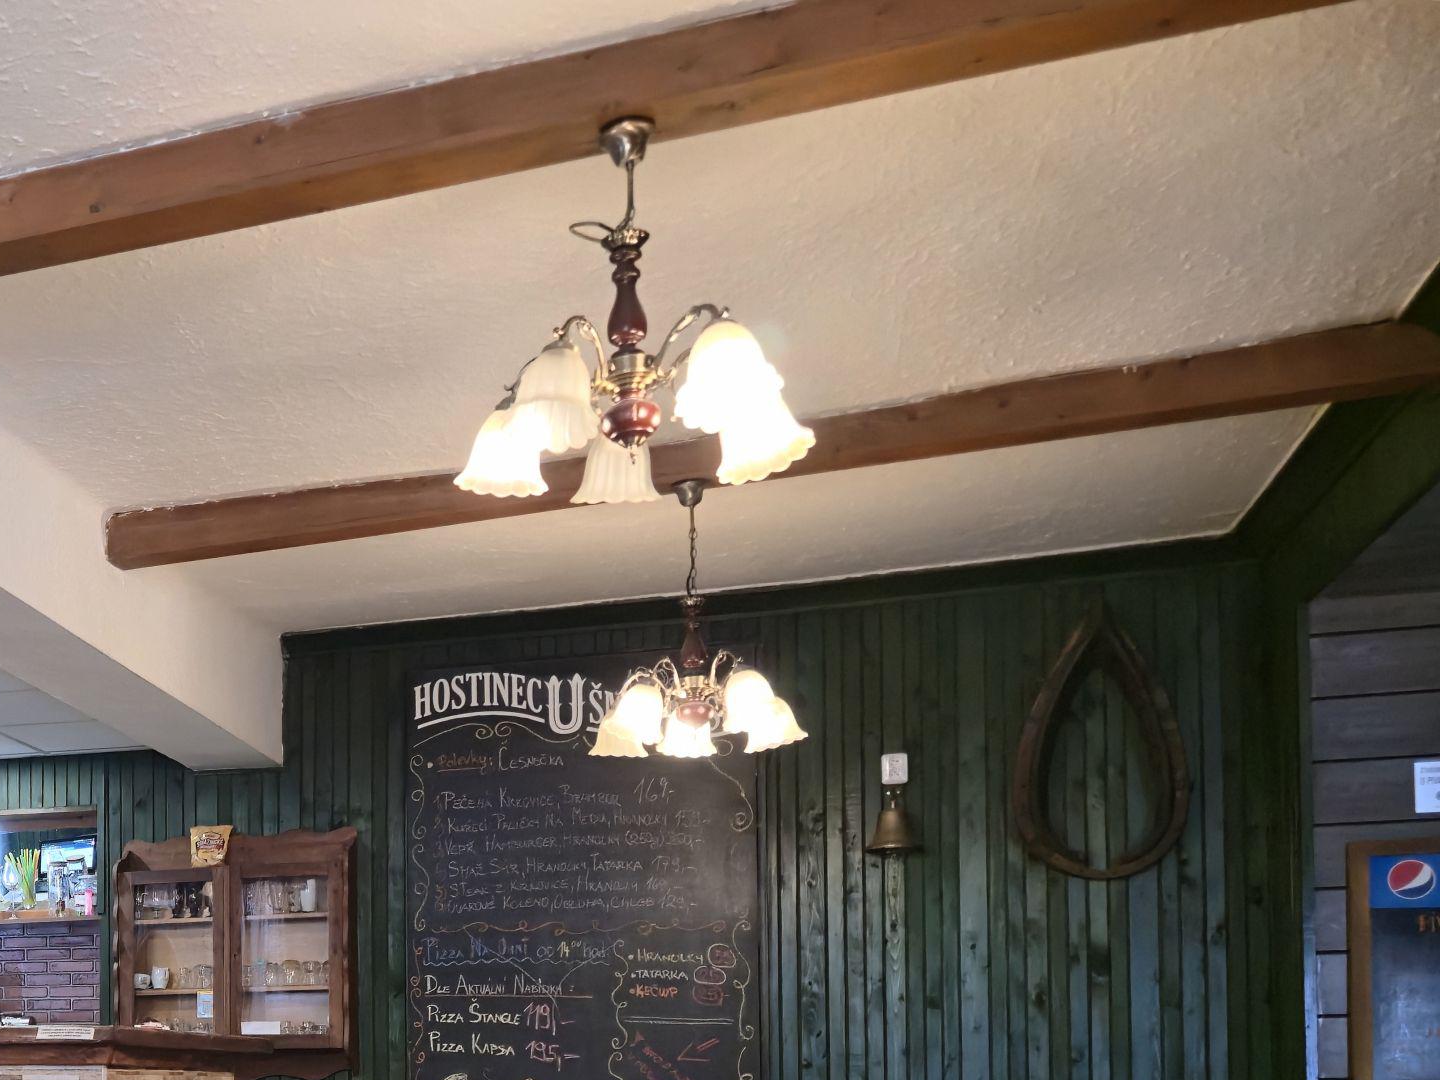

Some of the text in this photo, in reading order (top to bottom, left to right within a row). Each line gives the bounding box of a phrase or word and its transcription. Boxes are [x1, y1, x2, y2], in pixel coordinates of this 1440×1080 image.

[413, 672, 545, 720] HOSTINEC
[545, 673, 586, 734] U
[635, 969, 688, 981] TATARKA
